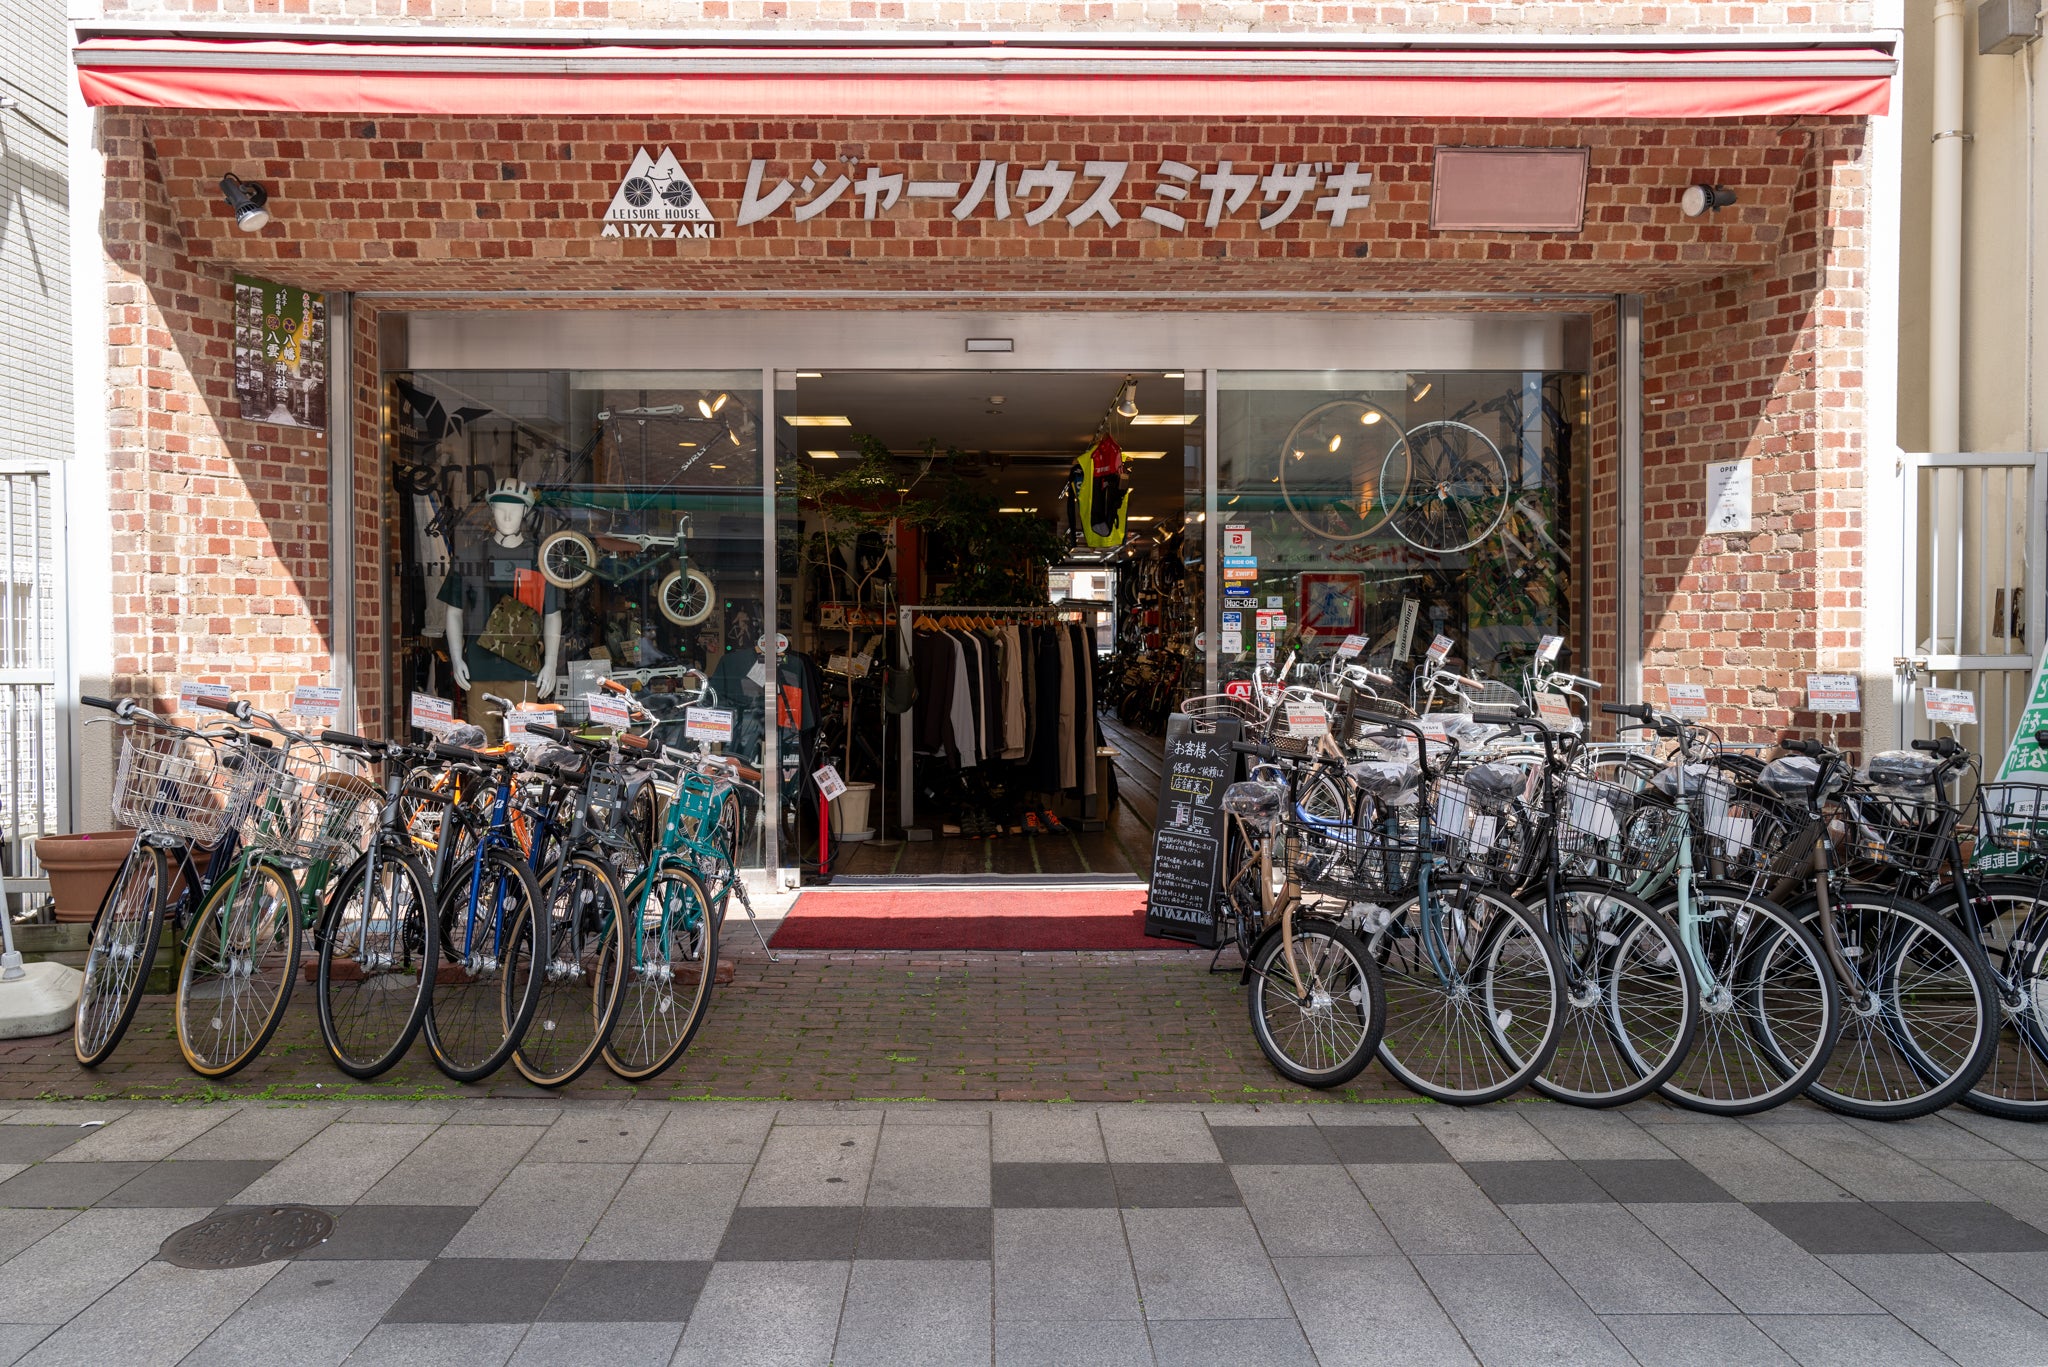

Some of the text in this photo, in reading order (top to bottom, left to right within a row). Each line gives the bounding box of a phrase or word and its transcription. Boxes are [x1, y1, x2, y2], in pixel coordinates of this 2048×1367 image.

[735, 155, 1373, 233] レジャーハウス ミヤザキ
[612, 209, 700, 219] LEISURE HOUSE
[600, 223, 715, 238] MIYAZAKI
[266, 330, 280, 358] 八雲
[283, 334, 296, 361] 八幡
[681, 445, 706, 471] SURLY
[1720, 465, 1738, 473] OPEN
[1226, 599, 1257, 607] Muc-Off
[1174, 740, 1220, 759] お客様へ
[1172, 762, 1224, 778] 修理のご依頼は
[1150, 906, 1202, 925] MIYAZAKI
